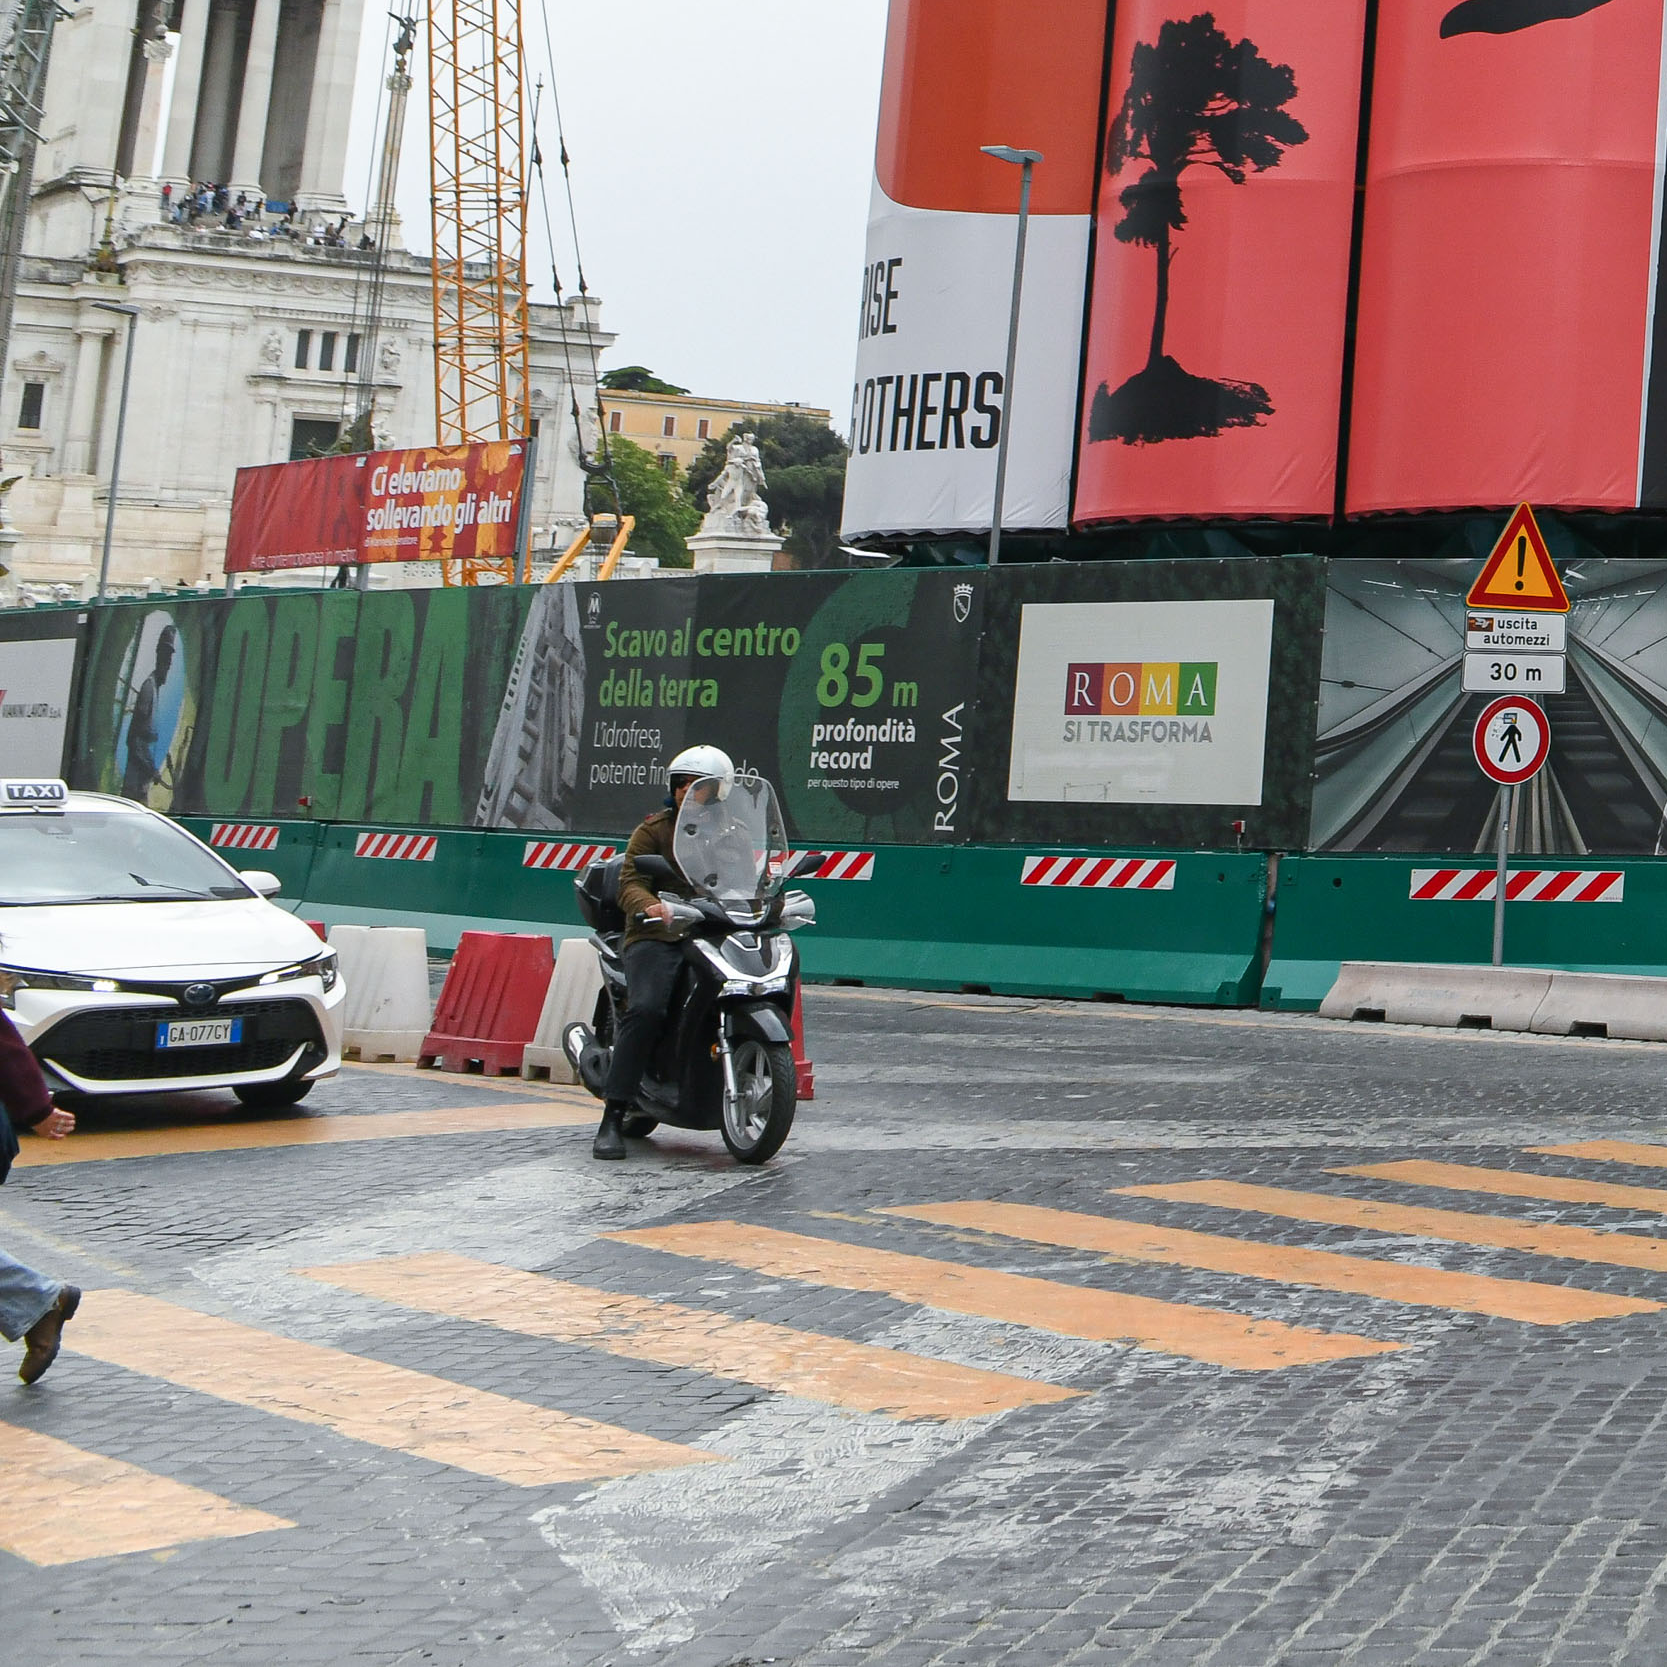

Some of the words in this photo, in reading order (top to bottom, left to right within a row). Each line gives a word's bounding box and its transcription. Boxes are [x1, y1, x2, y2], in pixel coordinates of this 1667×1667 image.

[859, 371, 1004, 455] OTHERS
[371, 464, 388, 496] Ci
[389, 460, 462, 494] eleviamo
[366, 495, 450, 532] sollevando
[453, 493, 476, 534] gli
[477, 491, 513, 524] altri
[251, 553, 266, 568] Arte
[266, 550, 325, 570] contemporanea
[335, 548, 357, 564] metro
[603, 620, 667, 658] Scavo
[670, 617, 692, 657] al
[696, 621, 801, 657] centro
[1497, 617, 1538, 631] uscita
[1483, 634, 1551, 646] automezzi
[600, 668, 654, 708] della
[658, 673, 719, 708] terra
[816, 642, 885, 708] 85
[892, 681, 918, 707] m
[1490, 663, 1517, 682] 30
[1525, 668, 1542, 681] m
[1071, 671, 1208, 707] ROMA
[204, 586, 469, 825] OPERA
[593, 720, 663, 753] L'idrofresa,
[812, 717, 917, 747] profondità
[1063, 721, 1082, 743] SI
[1087, 721, 1213, 743] TRASFORMA
[810, 746, 873, 770] record
[934, 702, 965, 832] ROMA
[589, 761, 648, 790] potente
[807, 778, 821, 790] per
[822, 778, 848, 790] questo
[850, 777, 866, 789] tipo
[867, 777, 876, 789] di
[876, 779, 900, 791] opere
[9, 785, 62, 799] TAXI
